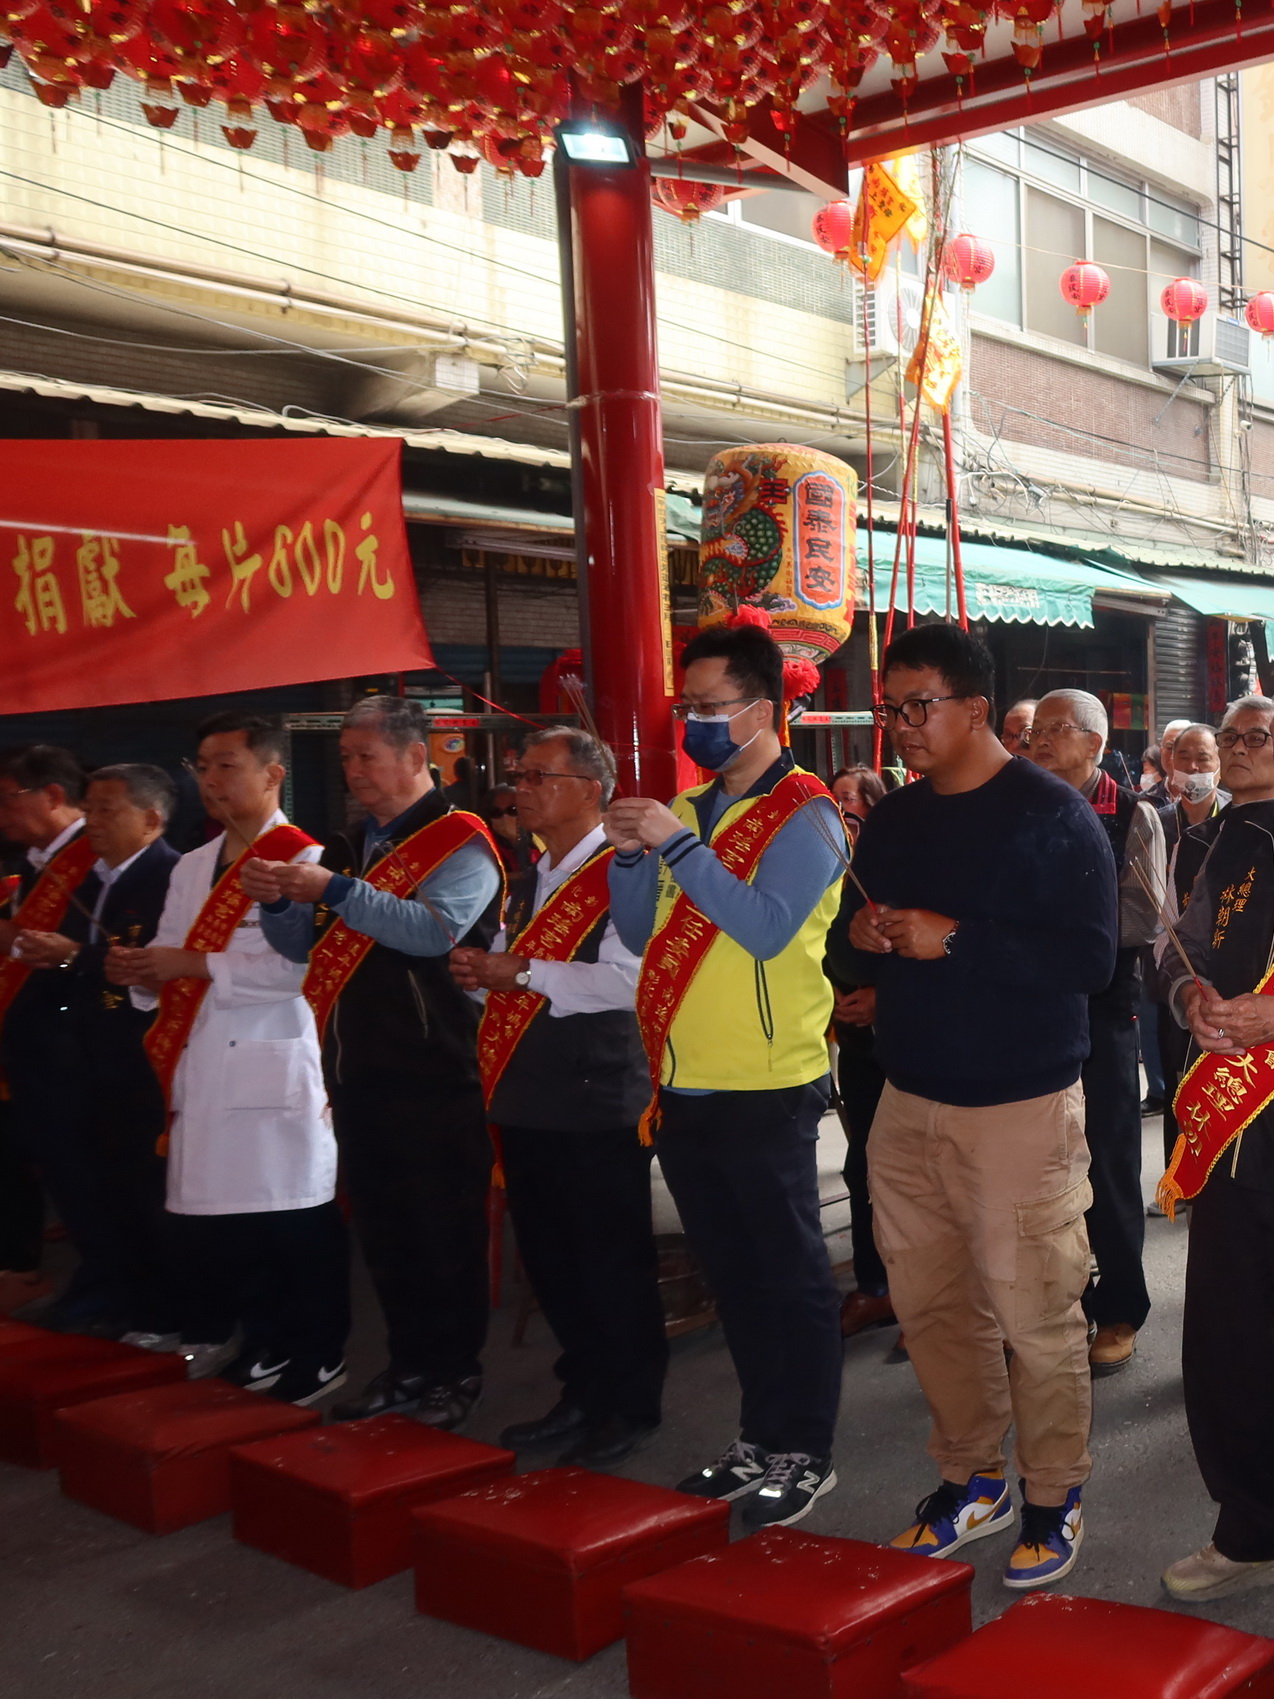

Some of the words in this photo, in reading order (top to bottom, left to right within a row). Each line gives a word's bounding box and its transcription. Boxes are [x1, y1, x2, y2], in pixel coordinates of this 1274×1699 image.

[12, 528, 136, 636] 捐獻
[803, 481, 838, 593] 國泰民安
[1233, 866, 1257, 912] 大總理
